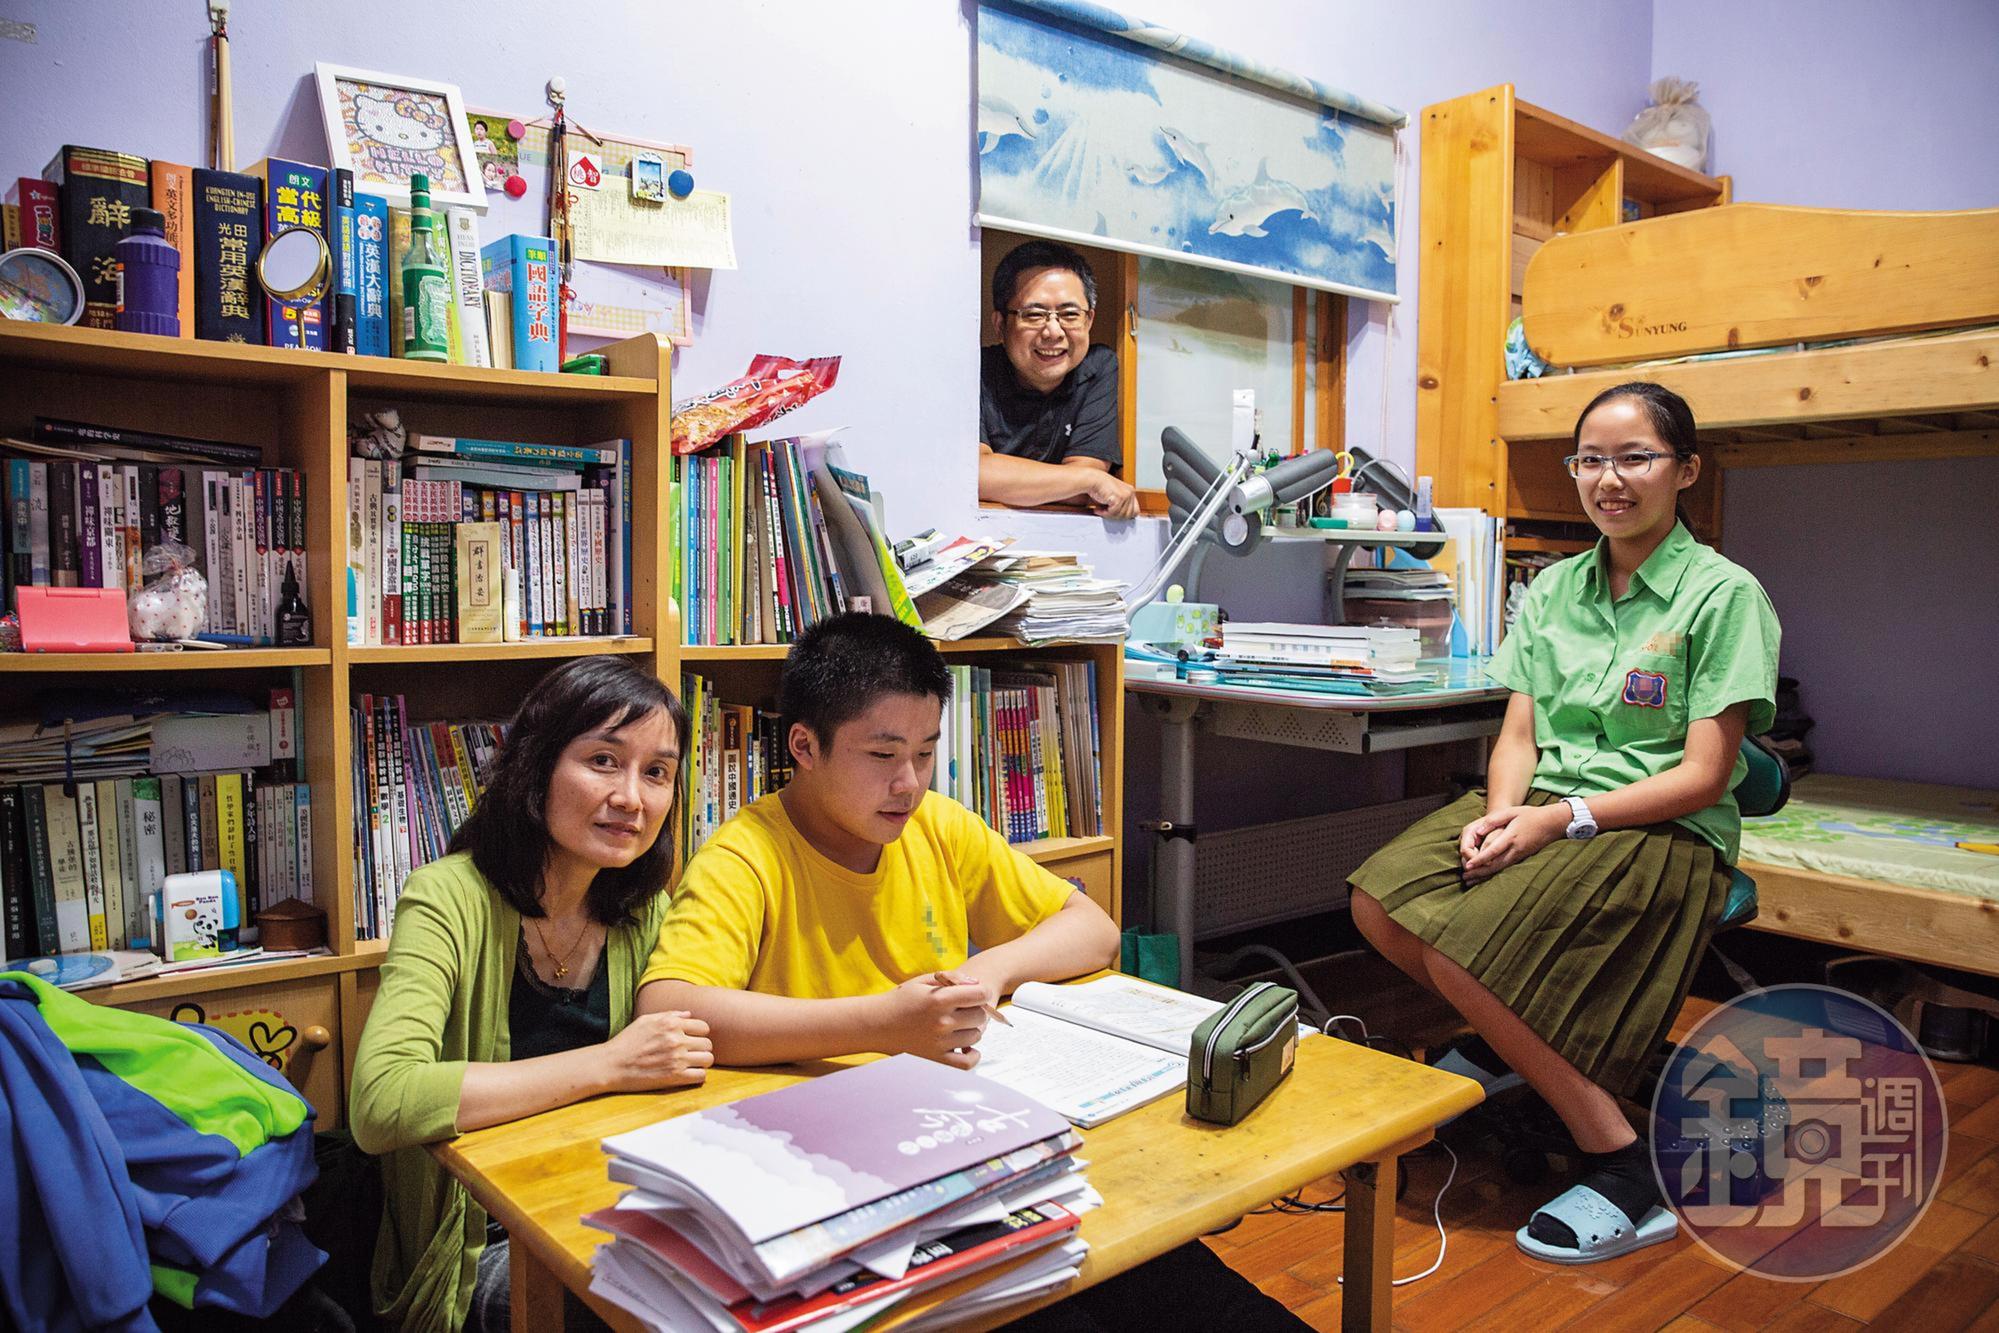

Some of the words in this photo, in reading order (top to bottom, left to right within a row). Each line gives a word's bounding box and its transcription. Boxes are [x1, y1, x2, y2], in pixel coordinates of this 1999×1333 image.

[369, 146, 445, 169] HELLO
[288, 174, 311, 187] 朗文
[374, 159, 444, 181] KITTY
[206, 195, 256, 209] ENGLISH-CHINESE
[214, 203, 249, 216] DICTIONARY
[276, 187, 322, 210] 當代
[276, 205, 322, 229] 高級
[218, 222, 247, 238] 光田
[219, 237, 250, 320] 常用英漢辭典
[365, 243, 383, 318] 英漢大辭典
[459, 250, 481, 310] DICTIONARY
[527, 263, 549, 343] 國語字典
[284, 343, 322, 352] PEASON
[143, 810, 156, 836] 秘密
